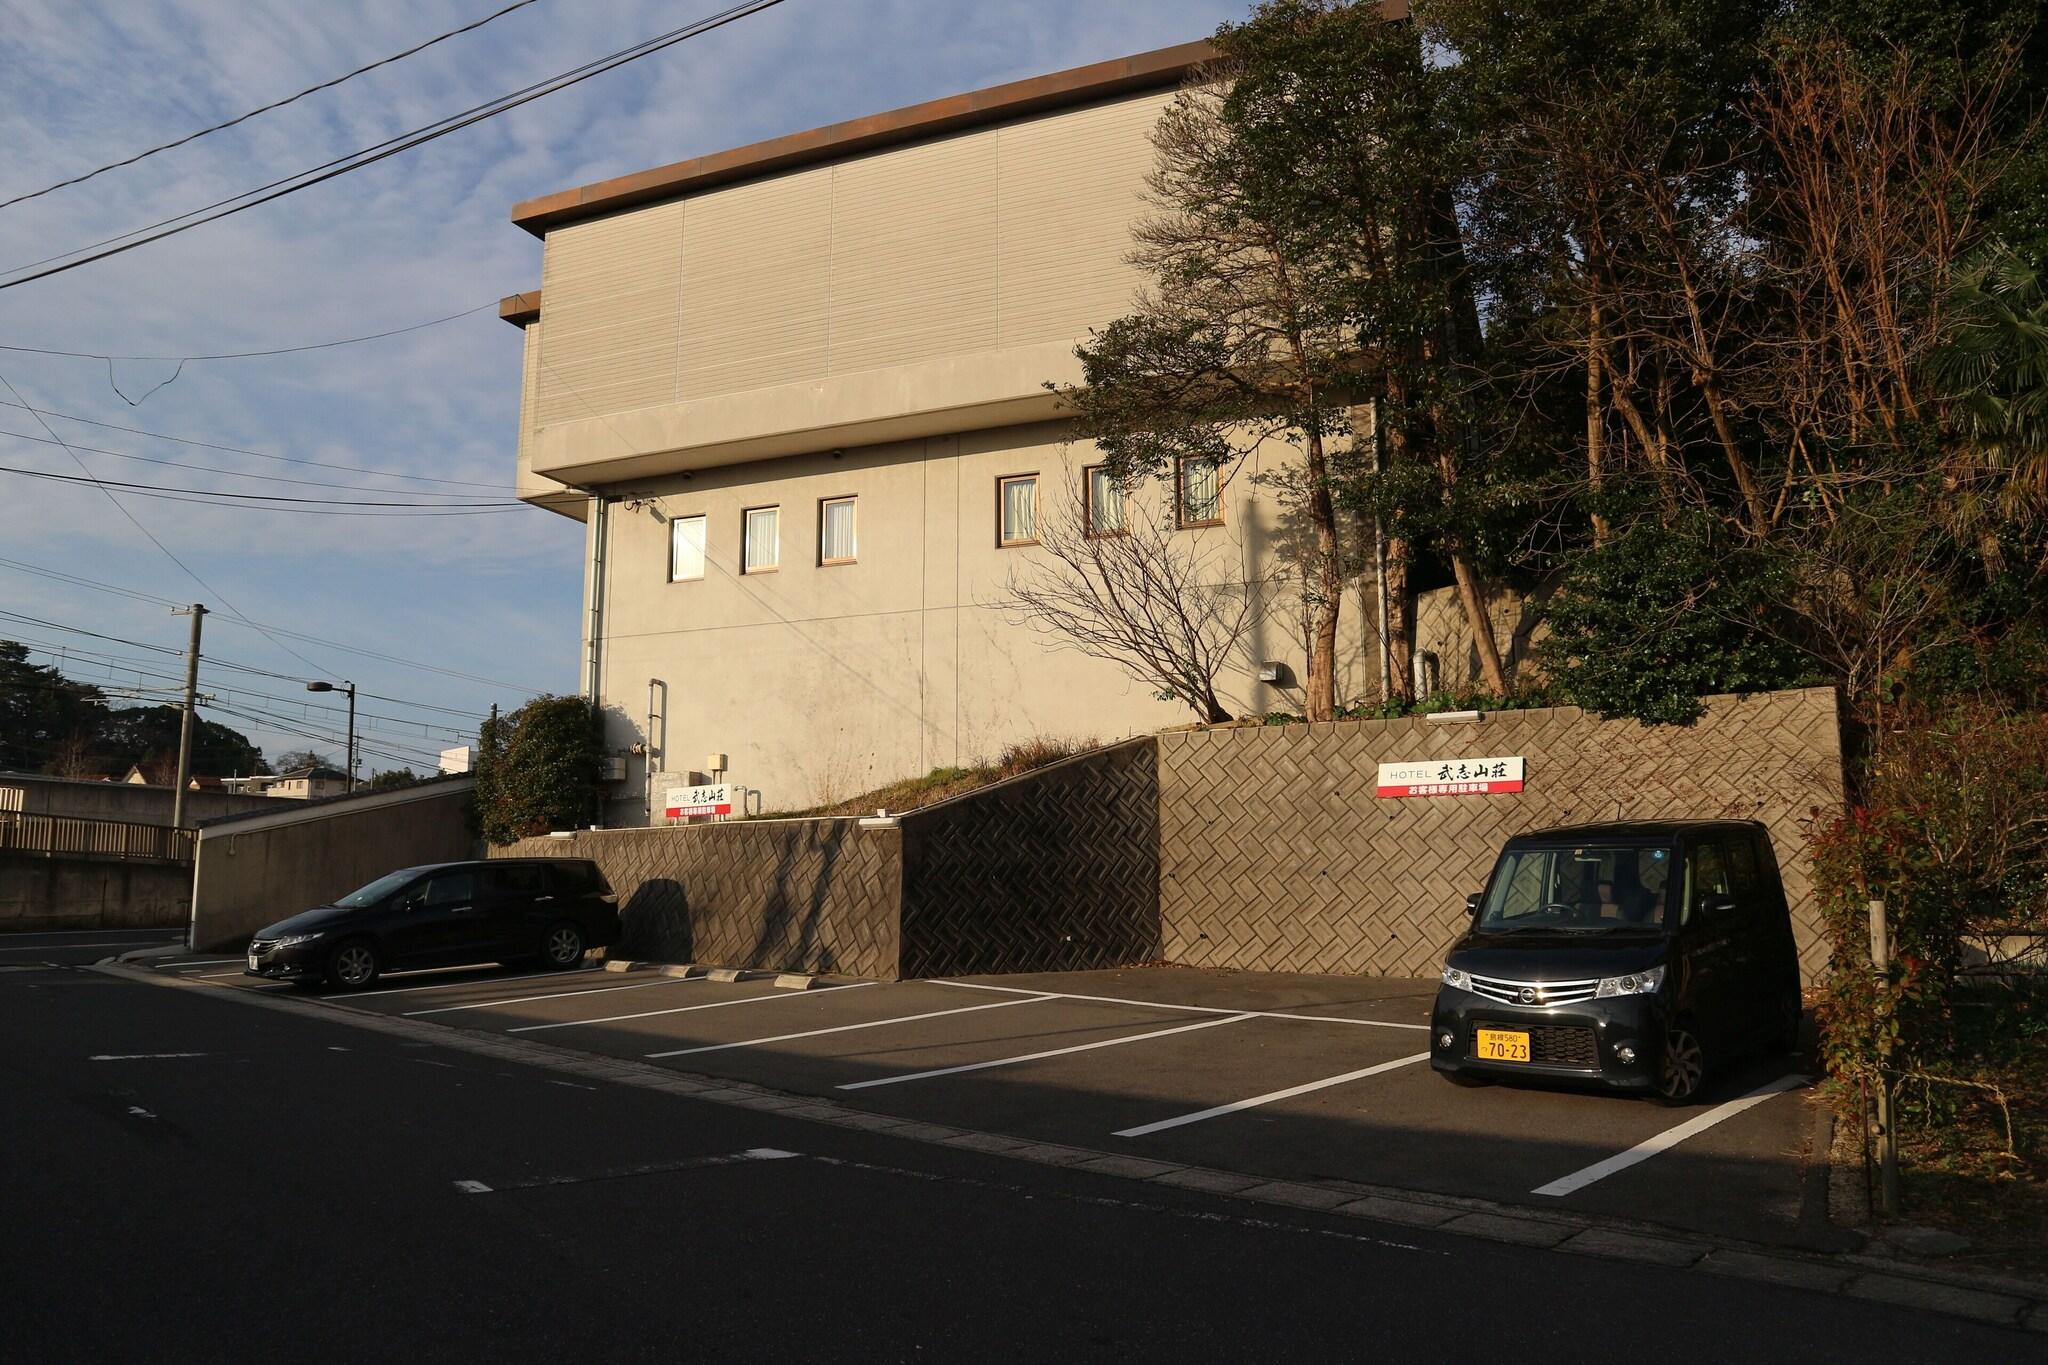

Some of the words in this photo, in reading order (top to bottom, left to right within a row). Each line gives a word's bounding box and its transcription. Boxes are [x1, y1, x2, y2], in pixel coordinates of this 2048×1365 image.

[1390, 770, 1432, 779] HOTEL
[1437, 762, 1507, 781] 武志山荘
[671, 794, 690, 802] HOTEL
[1489, 1042, 1527, 1059] 70-23
